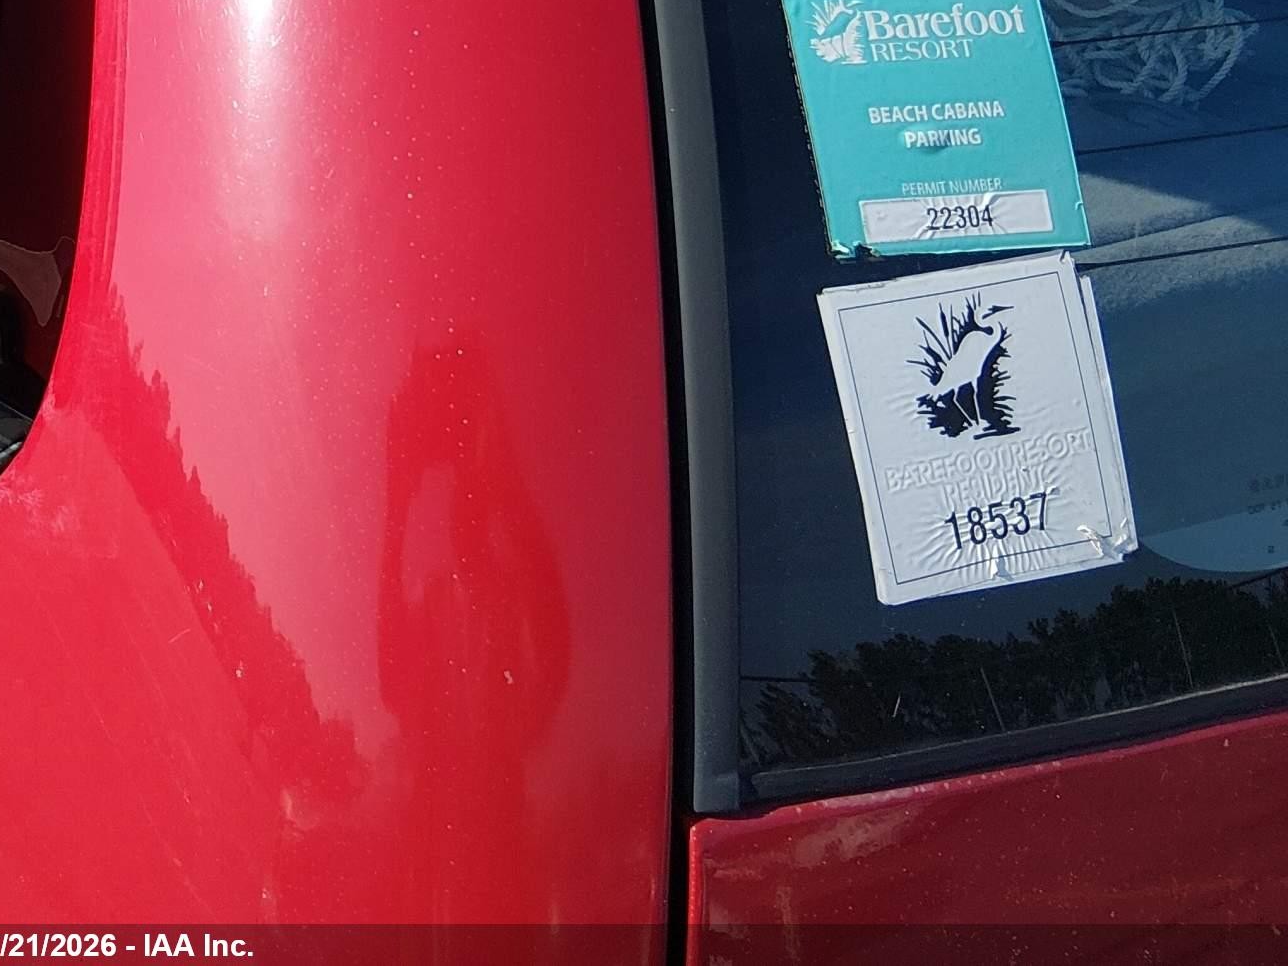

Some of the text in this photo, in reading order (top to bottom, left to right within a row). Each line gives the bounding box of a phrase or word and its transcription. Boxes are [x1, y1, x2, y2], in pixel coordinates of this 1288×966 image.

[863, 3, 1026, 40] Barefoot
[871, 39, 973, 61] RESORT
[868, 101, 1005, 124] BEACH CABANA
[904, 128, 982, 149] PARKING
[901, 178, 1003, 196] PERMIT NUMBER
[926, 204, 994, 231] 22304
[944, 491, 1048, 550] 18537
